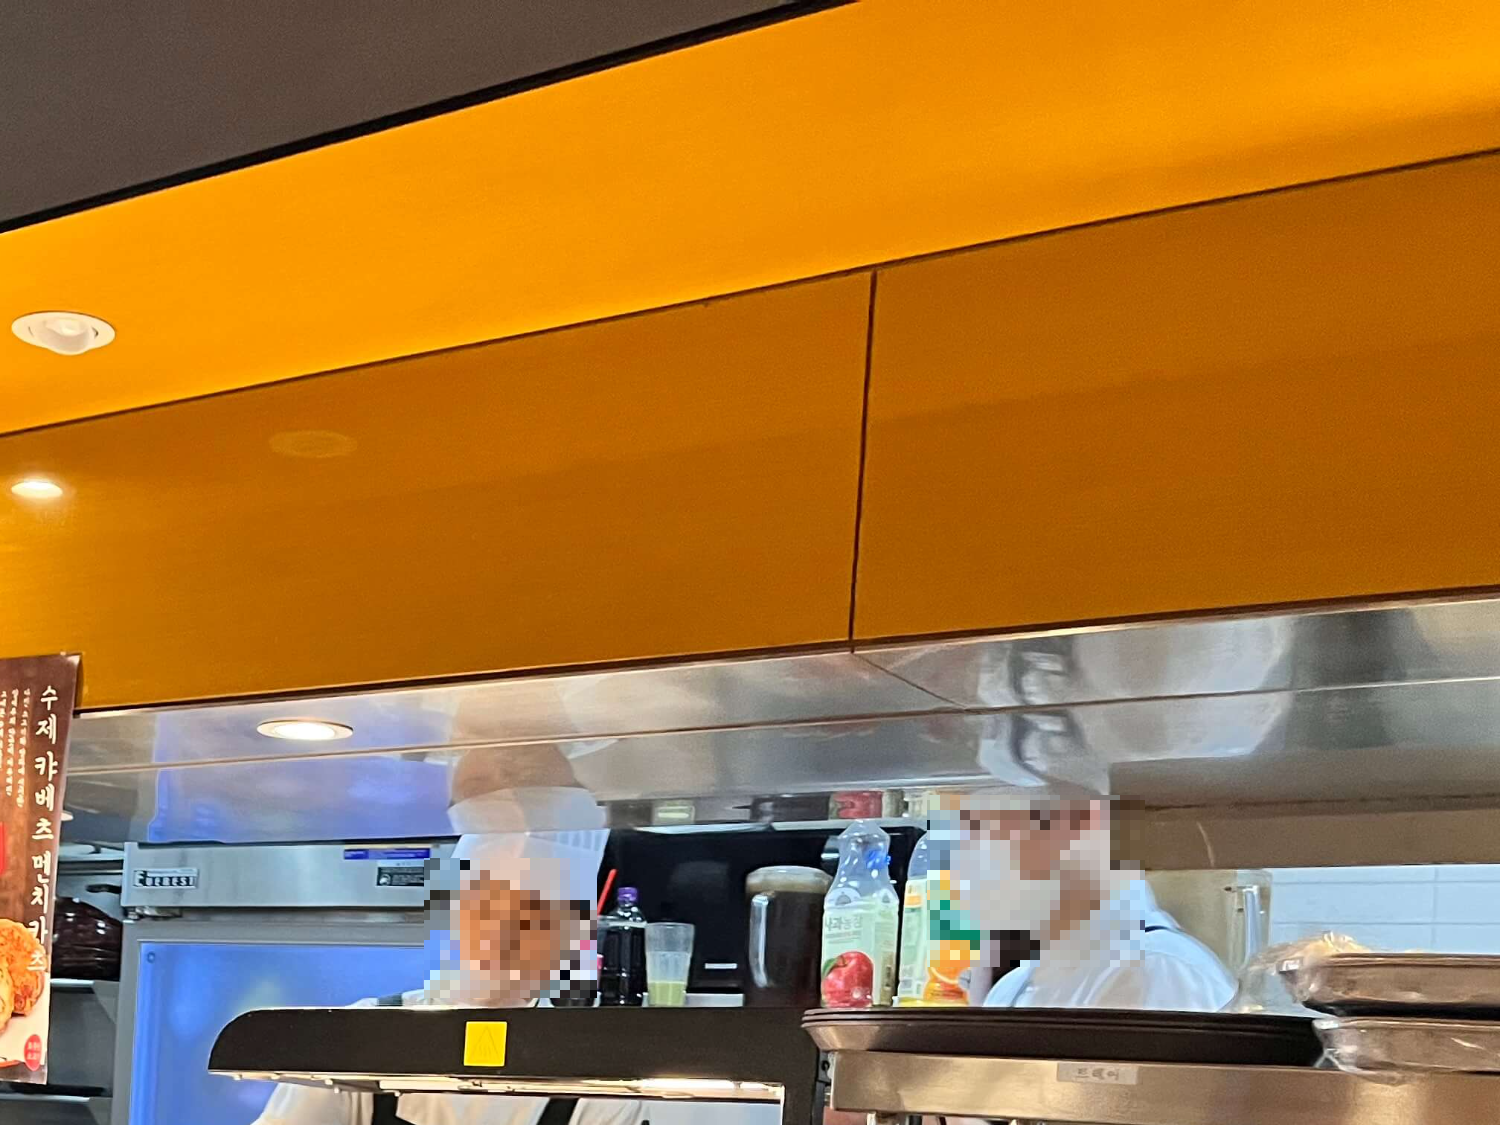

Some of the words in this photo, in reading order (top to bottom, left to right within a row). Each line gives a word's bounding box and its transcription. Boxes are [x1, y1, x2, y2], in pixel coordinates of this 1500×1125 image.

[35, 685, 58, 744] 수제
[31, 750, 58, 840] 캬베츠
[26, 850, 52, 971] 멘치카츠
